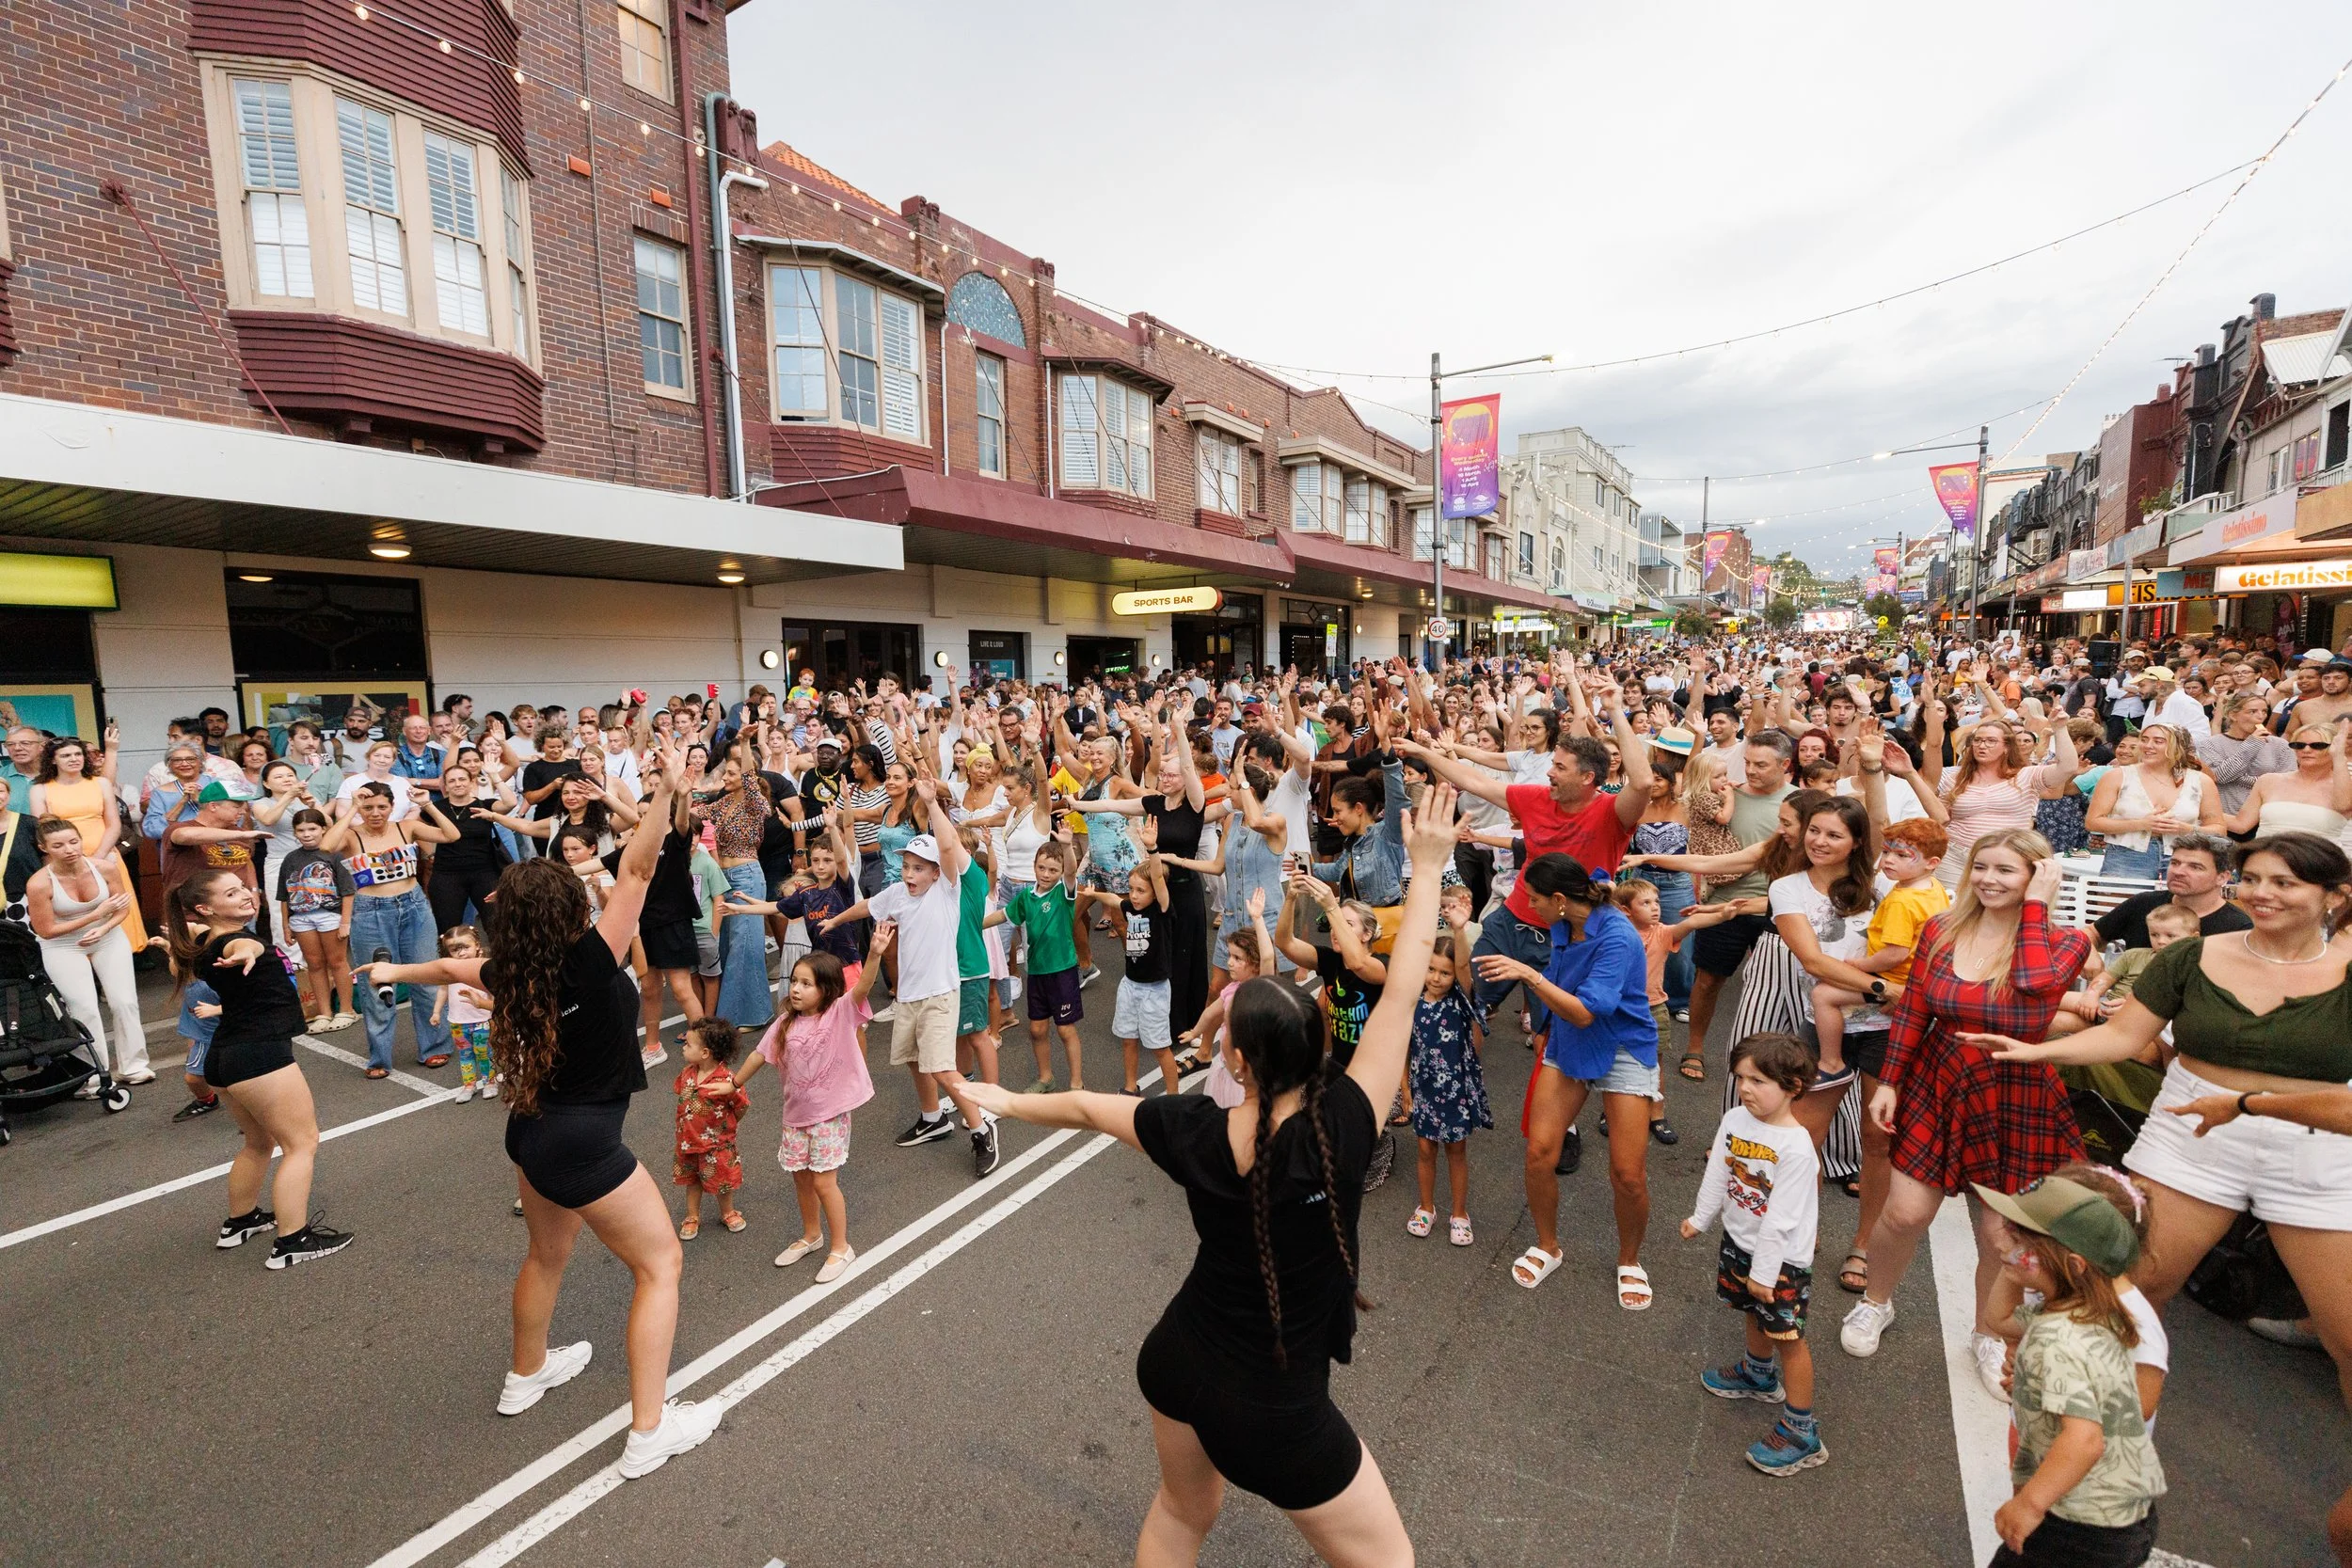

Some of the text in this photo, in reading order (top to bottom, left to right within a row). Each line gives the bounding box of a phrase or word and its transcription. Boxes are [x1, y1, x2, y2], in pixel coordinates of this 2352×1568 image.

[1134, 595, 1194, 607] SPORTS BAR
[1432, 625, 1444, 633] 40
